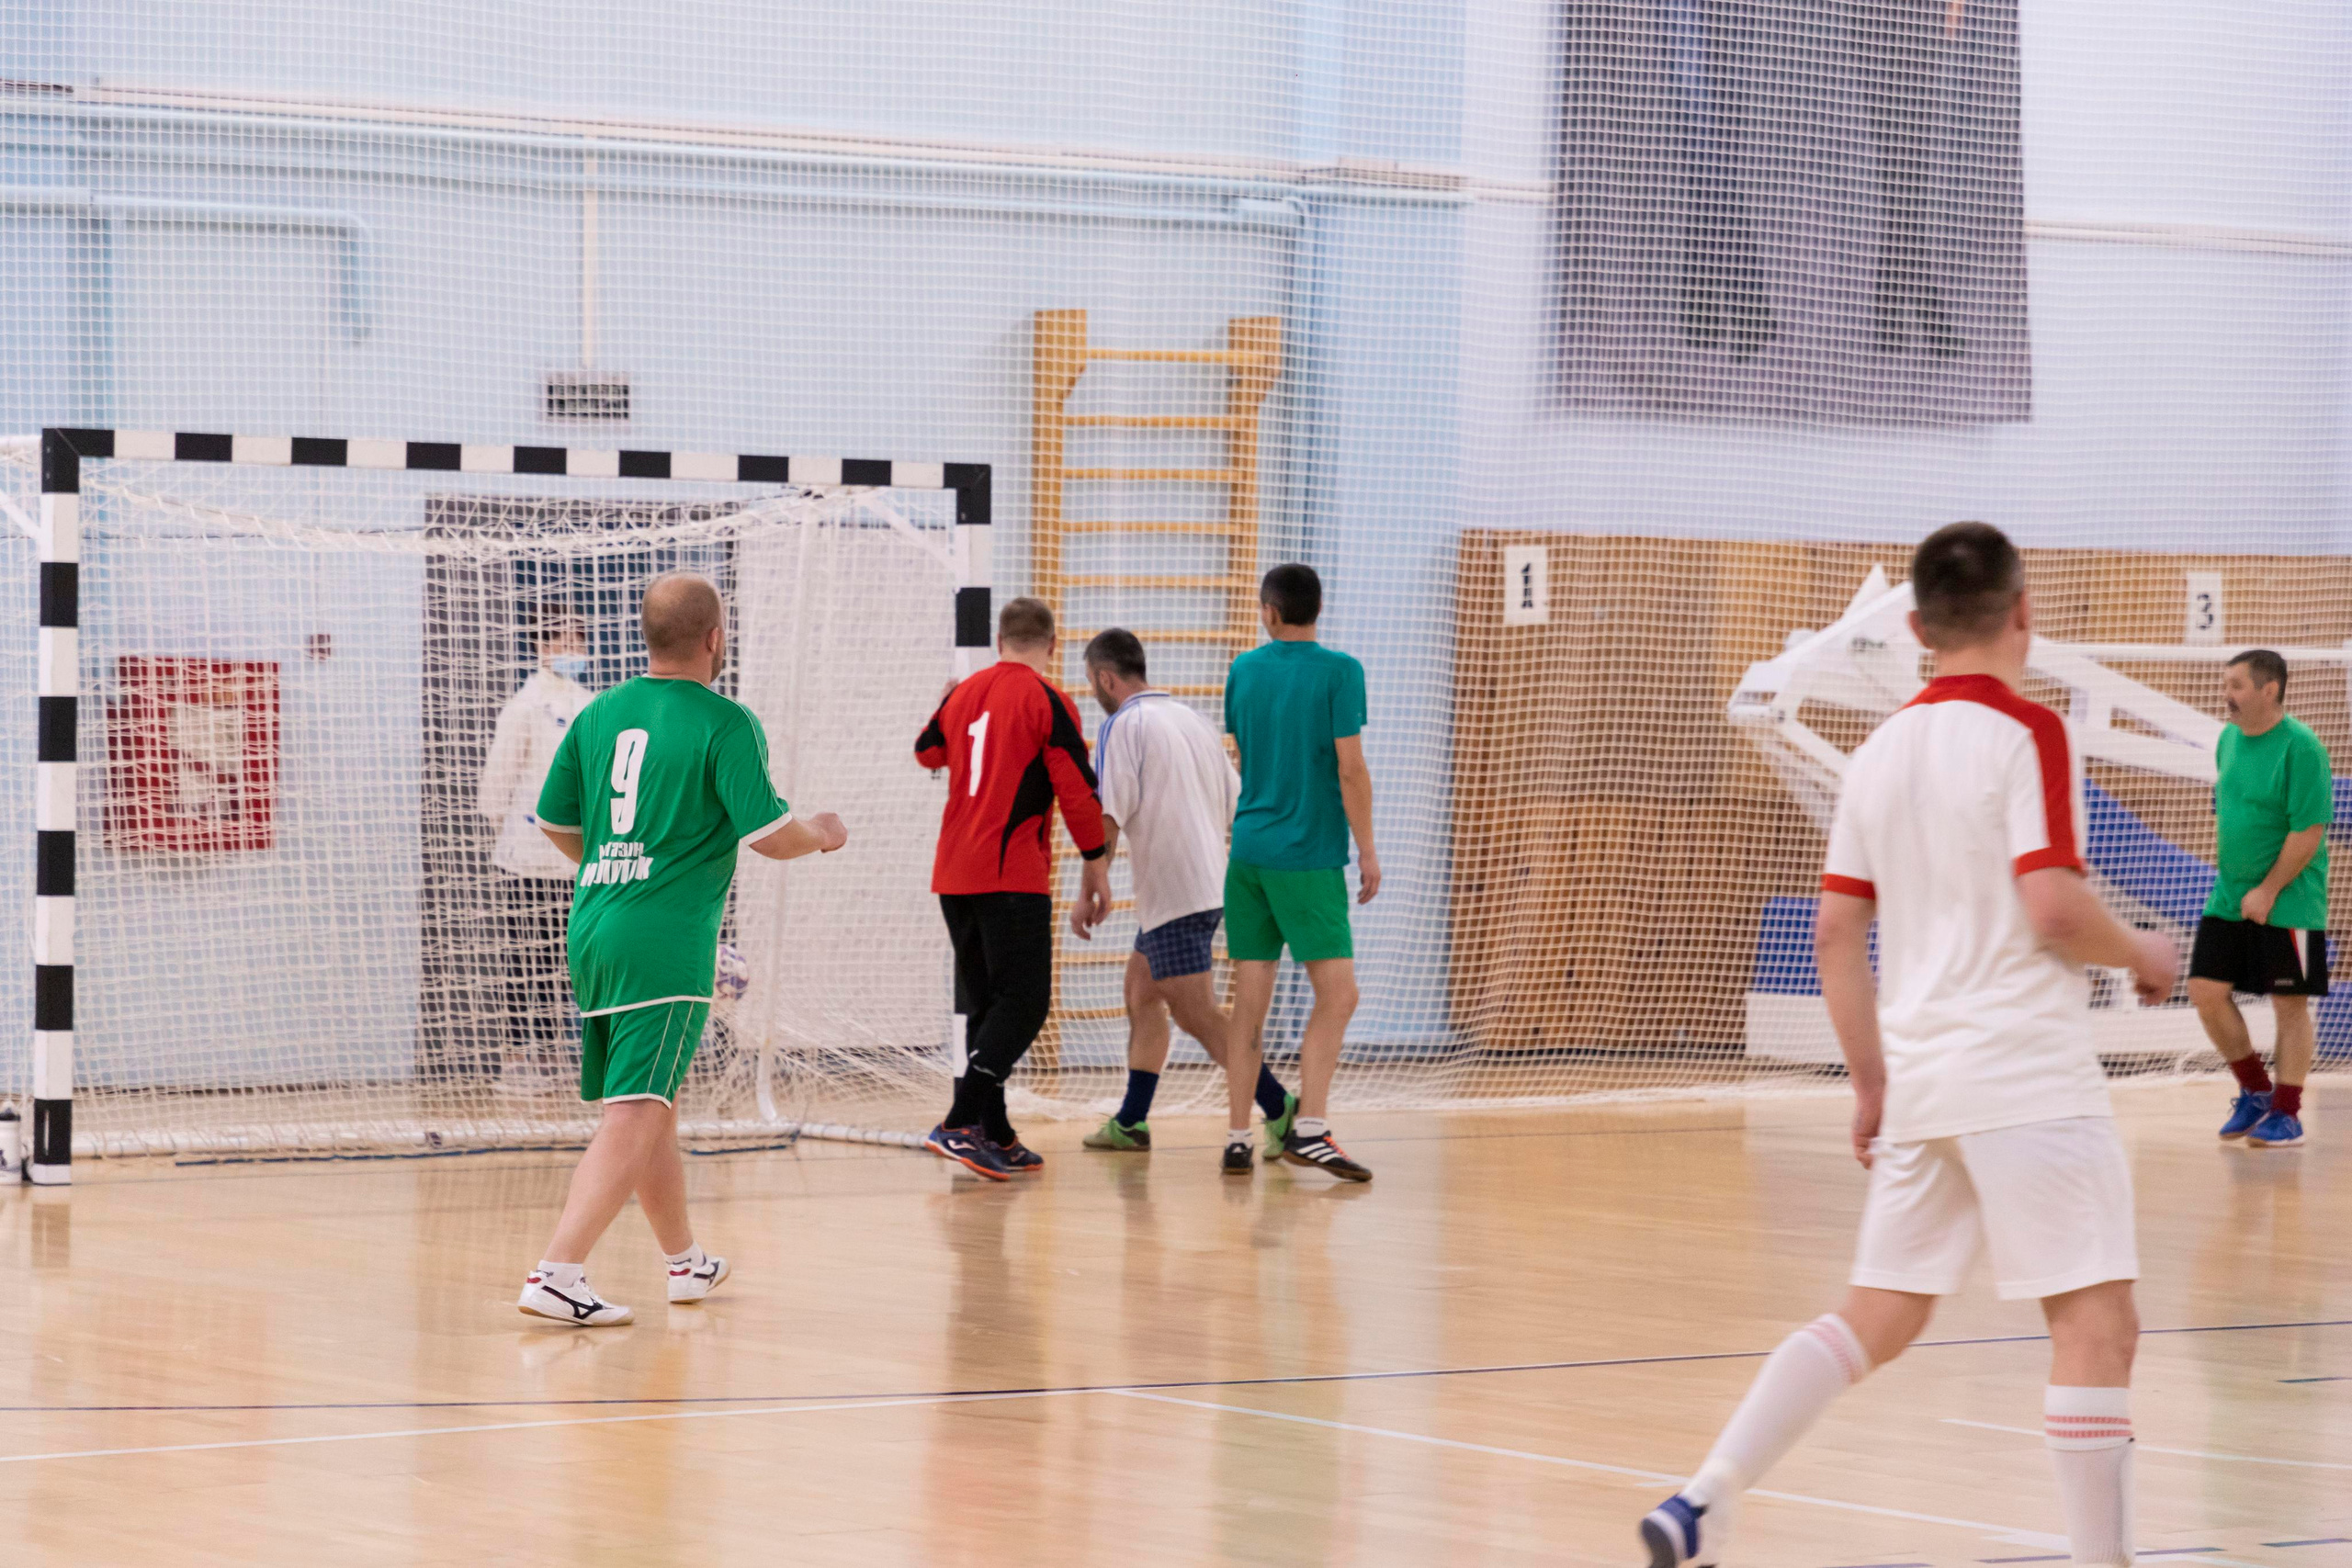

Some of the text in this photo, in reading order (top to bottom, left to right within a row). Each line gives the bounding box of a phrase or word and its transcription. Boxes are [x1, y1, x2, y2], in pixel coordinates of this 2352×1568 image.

[1521, 563, 1533, 609] 1
[2196, 593, 2214, 630] 3
[610, 728, 649, 835] 9
[967, 710, 990, 797] 1
